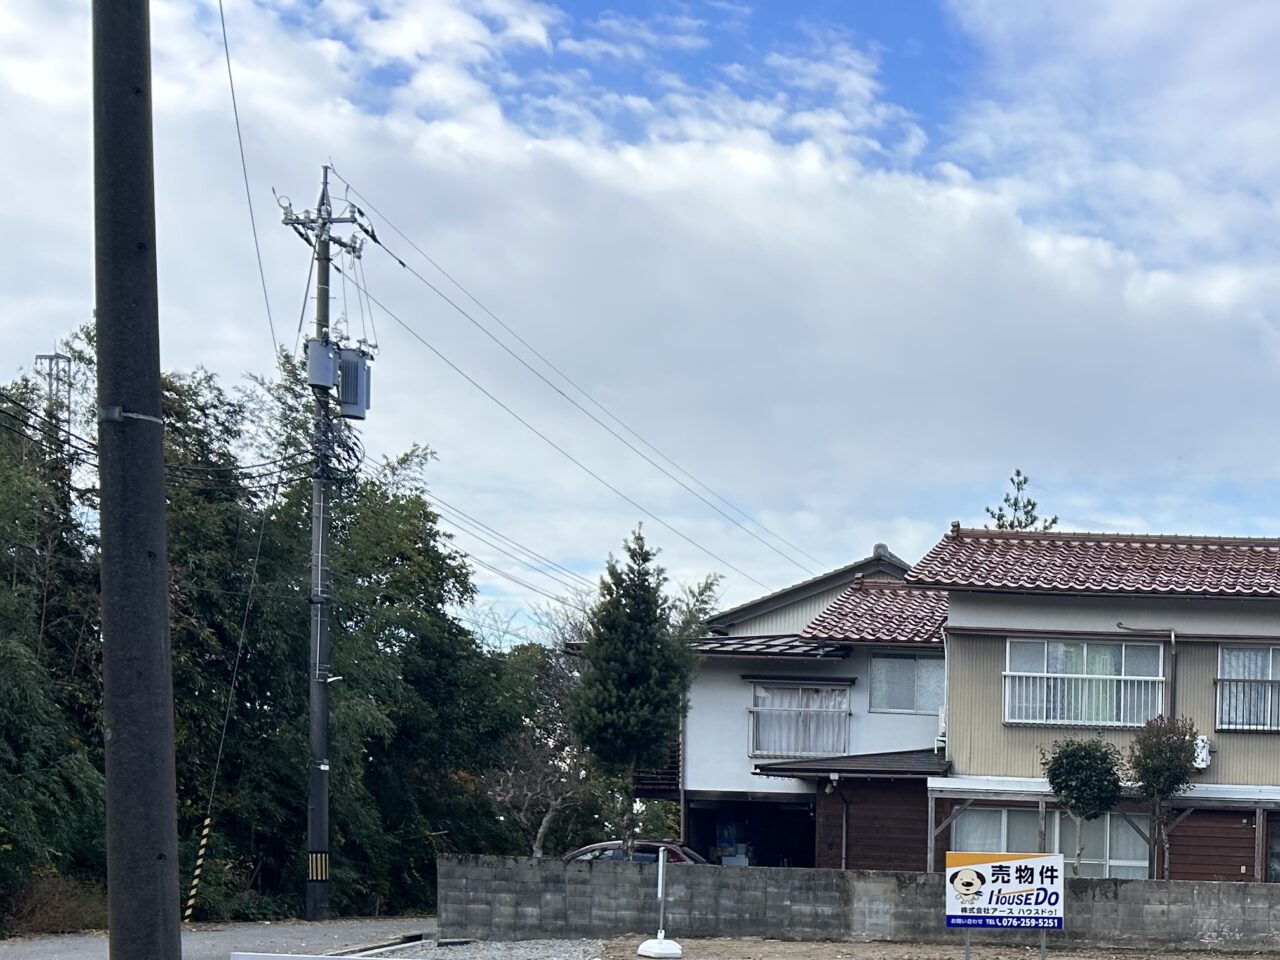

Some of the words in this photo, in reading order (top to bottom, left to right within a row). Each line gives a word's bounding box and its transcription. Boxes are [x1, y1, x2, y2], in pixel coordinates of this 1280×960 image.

[991, 865, 1058, 885] 売物件
[961, 907, 1014, 915] 株式会社アース
[1002, 918, 1058, 927] 076-259-5251
